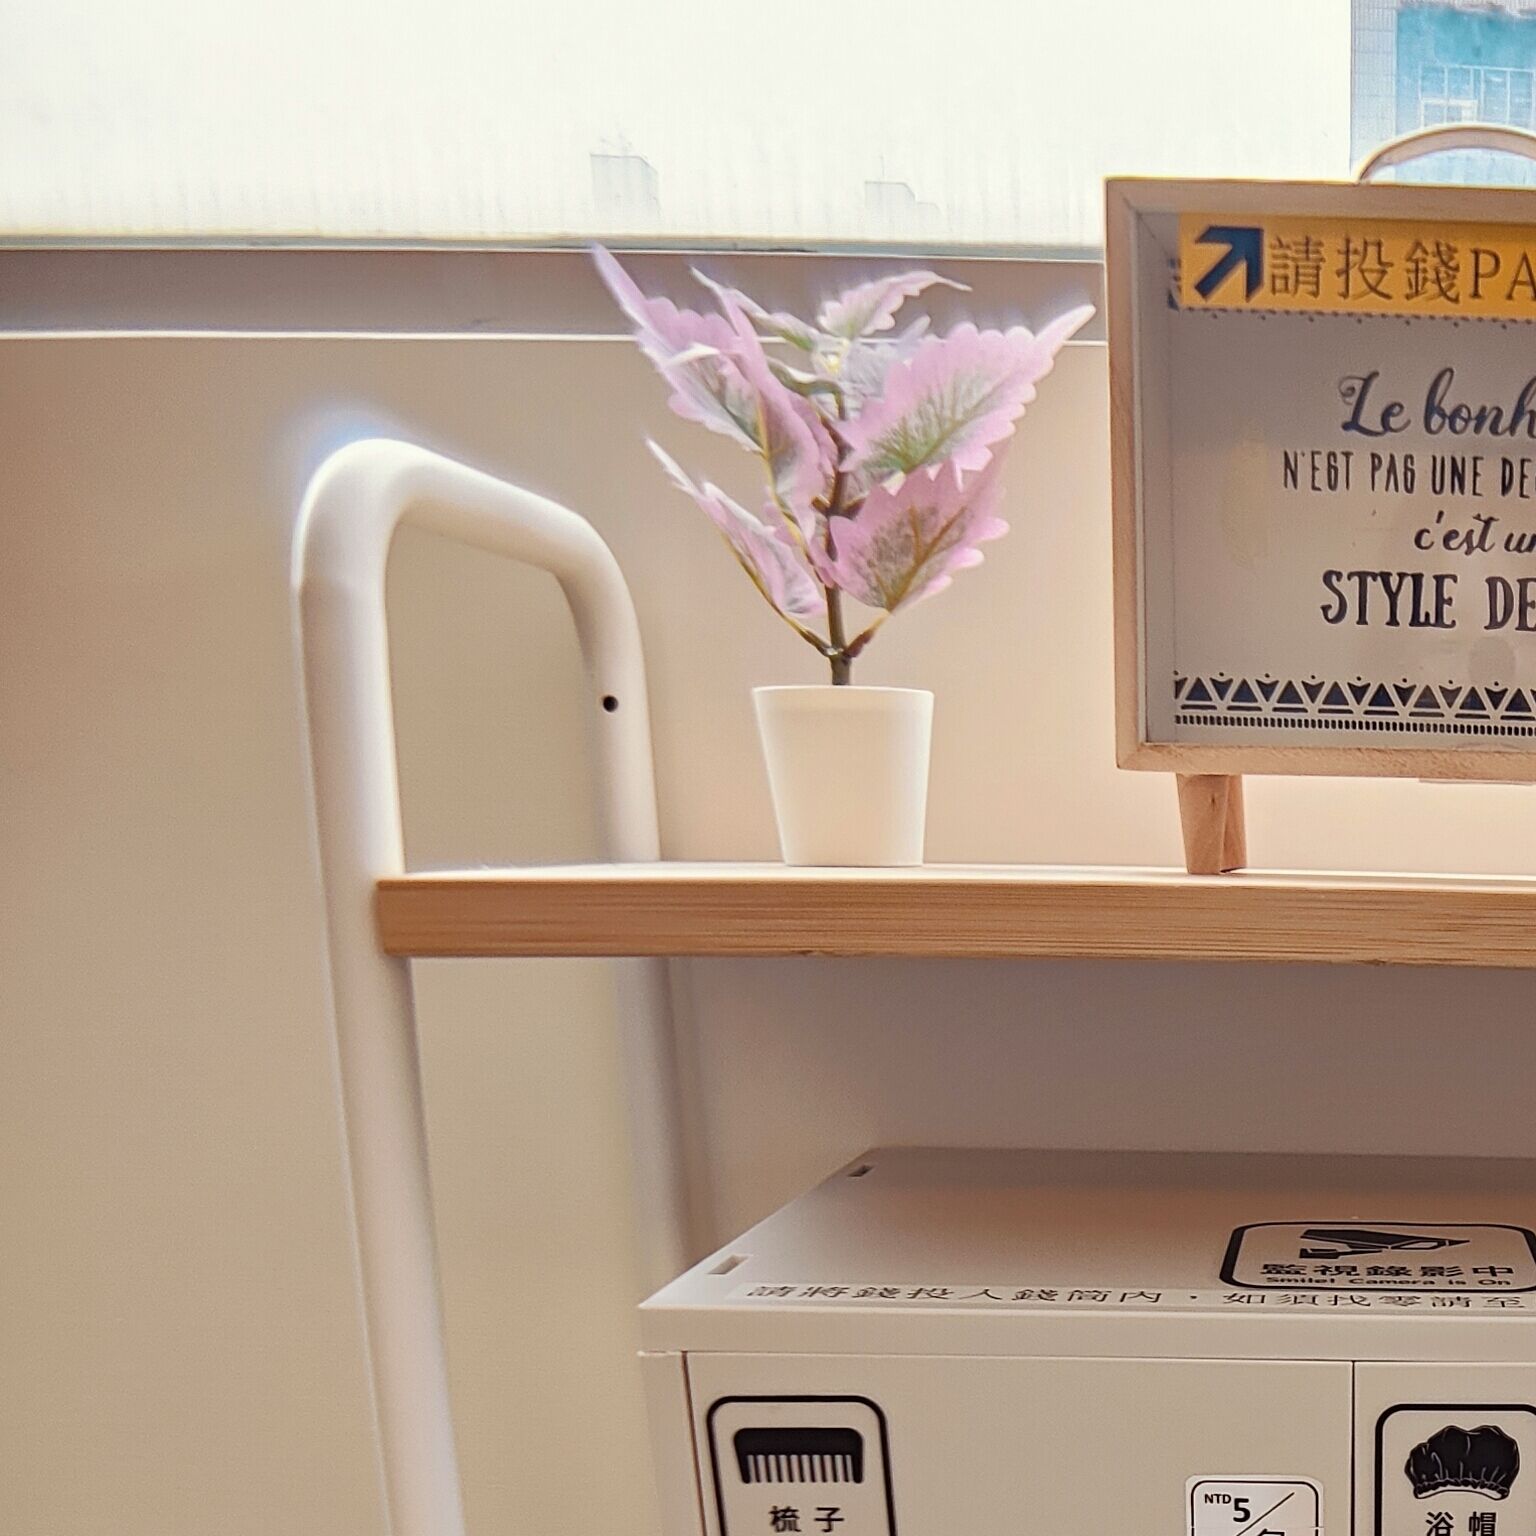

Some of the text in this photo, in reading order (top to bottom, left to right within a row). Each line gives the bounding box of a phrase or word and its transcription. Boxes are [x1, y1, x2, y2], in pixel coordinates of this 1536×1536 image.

[1269, 234, 1461, 305] 請投錢
[1338, 370, 1412, 438] Le
[1282, 449, 1355, 494] N'EST
[1370, 452, 1417, 494] PAS
[1430, 455, 1484, 497] UNE
[1414, 512, 1498, 554] c'est
[1319, 569, 1459, 630] STYLE
[1260, 1263, 1515, 1278] 監視錄影中
[768, 1505, 845, 1533] 梳子
[1204, 1493, 1251, 1523] NTD 5
